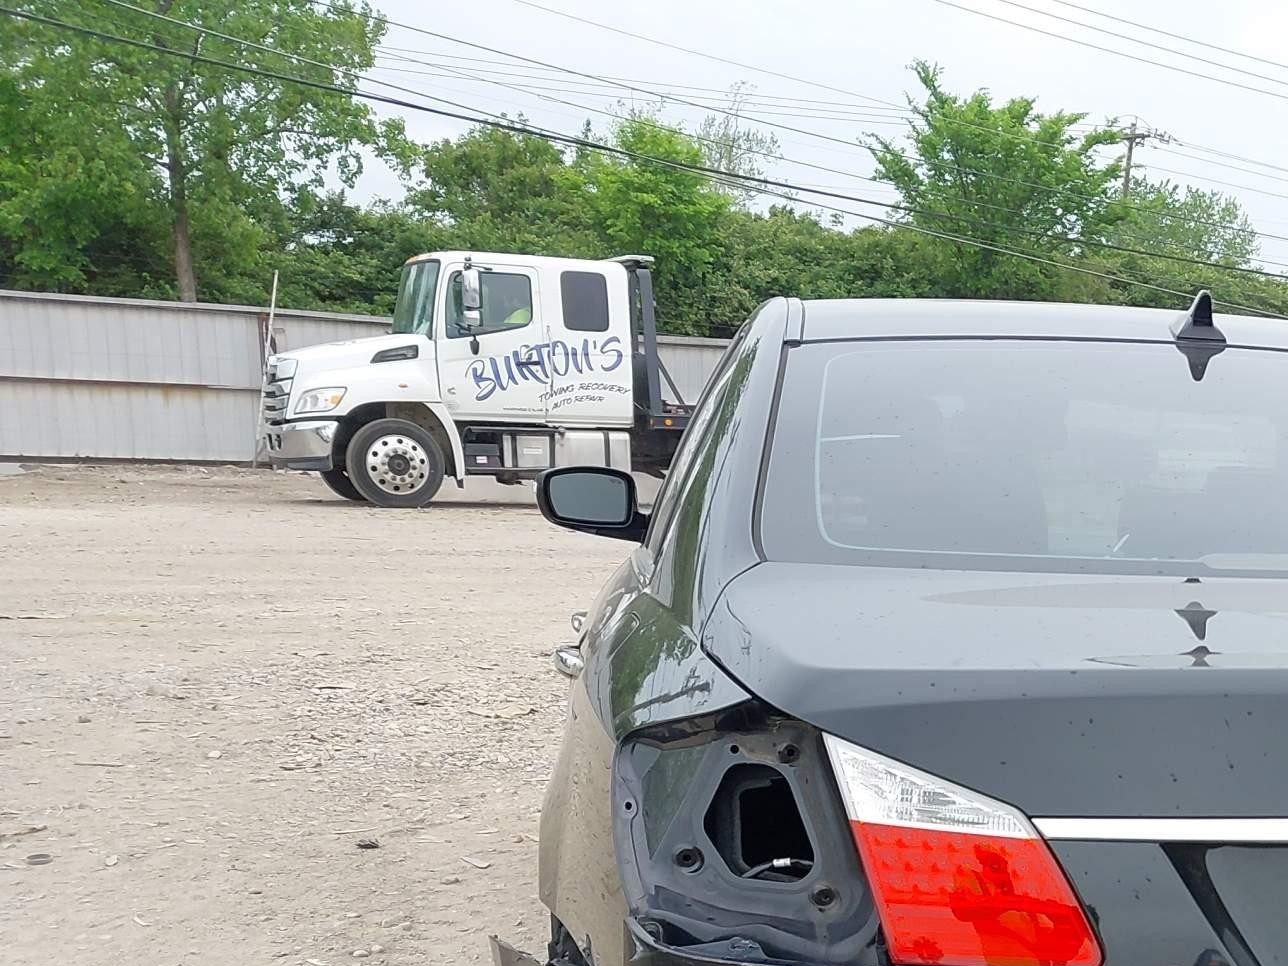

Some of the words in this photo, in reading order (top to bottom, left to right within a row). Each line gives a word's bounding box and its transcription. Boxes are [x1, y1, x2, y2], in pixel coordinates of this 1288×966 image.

[465, 336, 623, 401] BURTON'S
[539, 384, 575, 403] TOWING
[578, 382, 631, 394] RECOVERY
